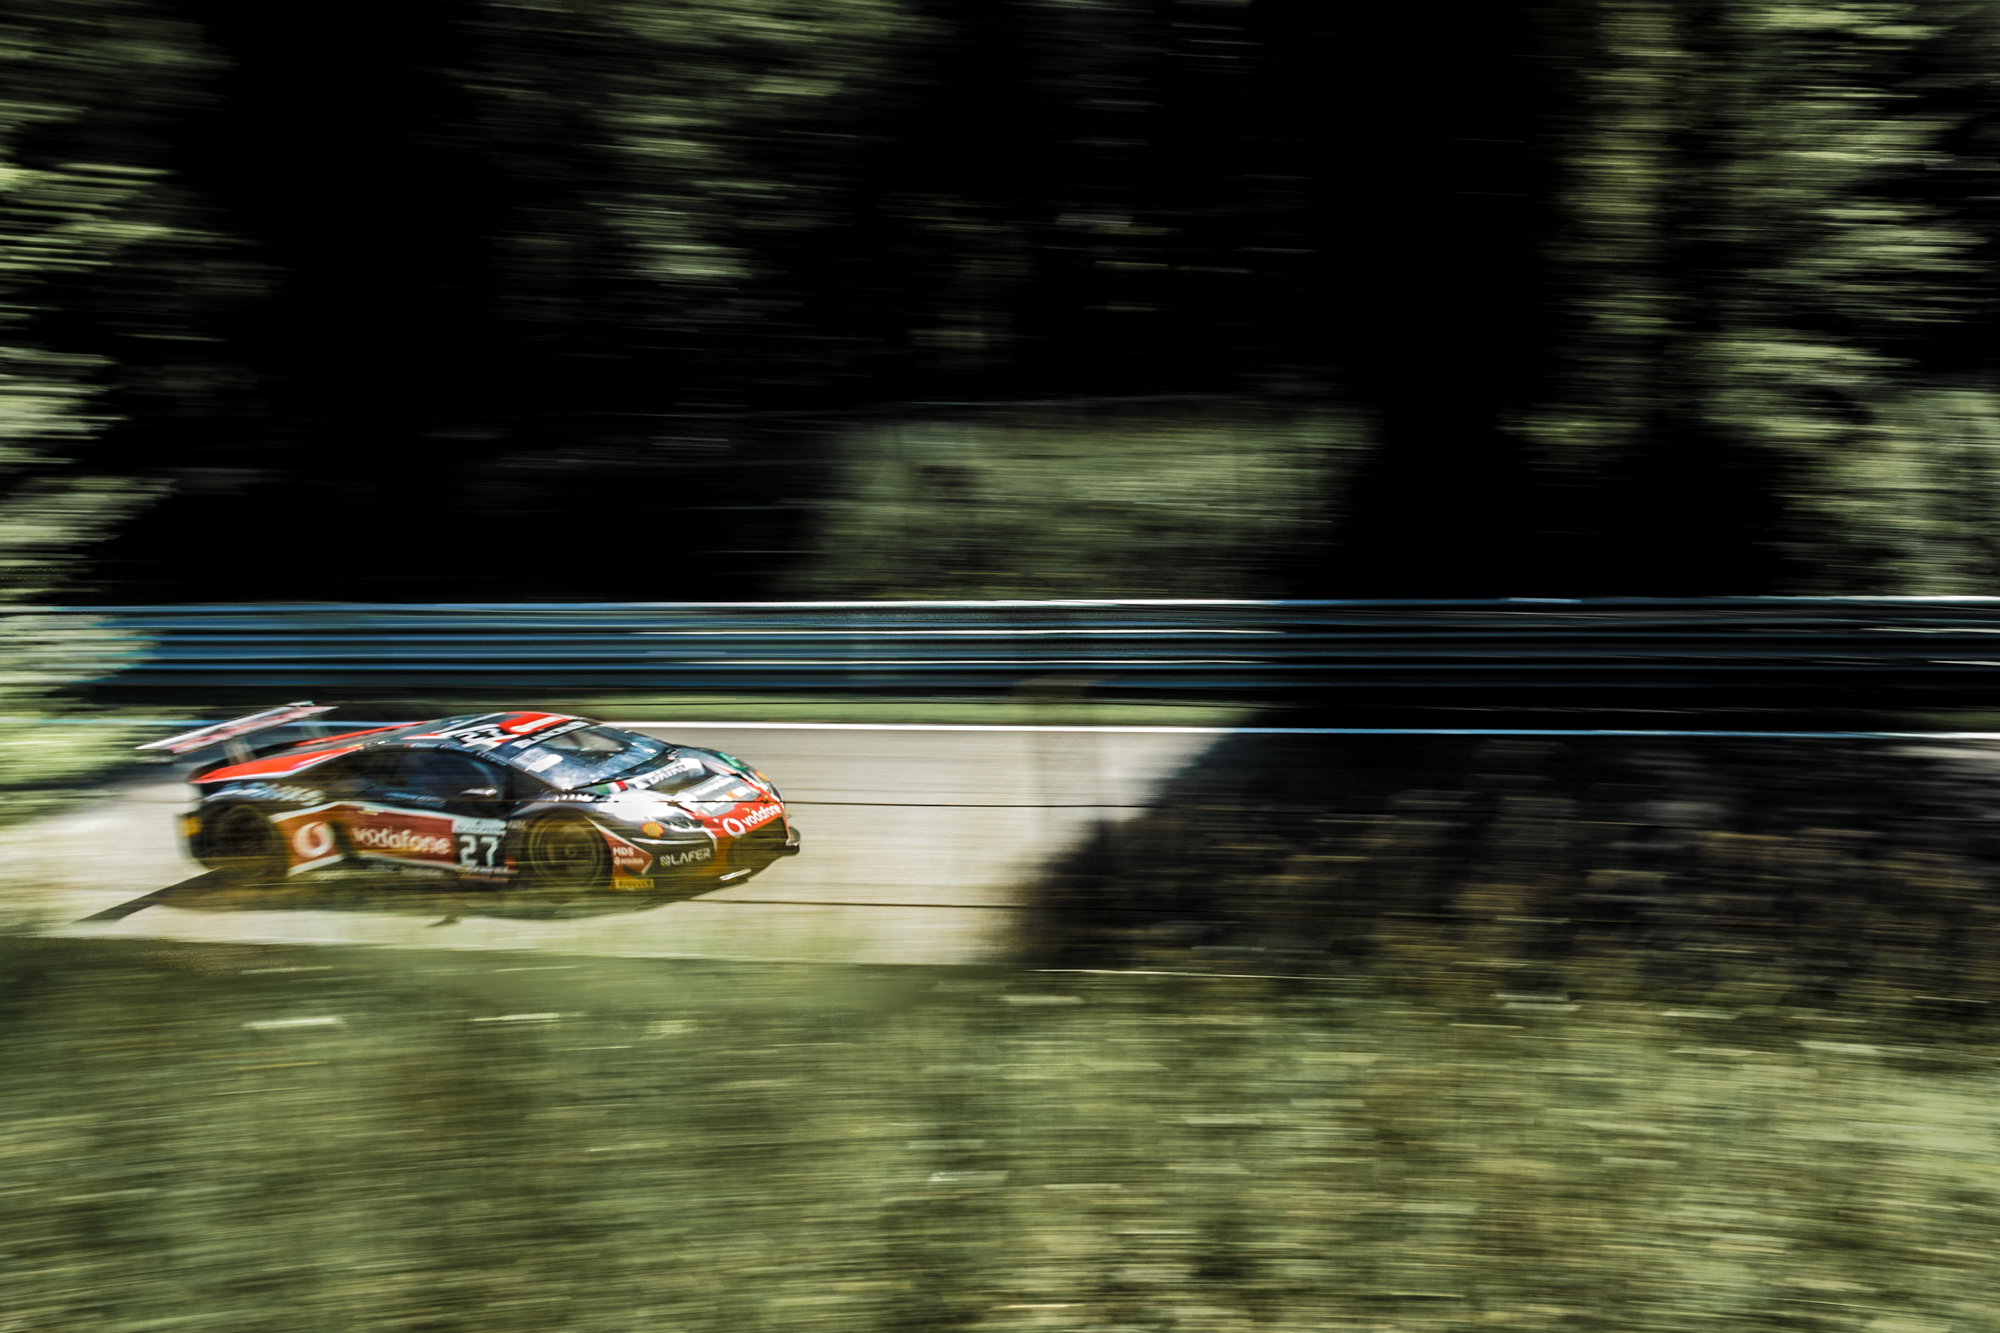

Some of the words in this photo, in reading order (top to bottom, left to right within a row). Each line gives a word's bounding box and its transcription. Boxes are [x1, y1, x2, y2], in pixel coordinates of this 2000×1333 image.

[741, 804, 782, 827] vodafone
[351, 826, 451, 855] vodafone
[459, 835, 499, 868] 27
[612, 847, 634, 856] MDS
[670, 848, 711, 866] LAFER
